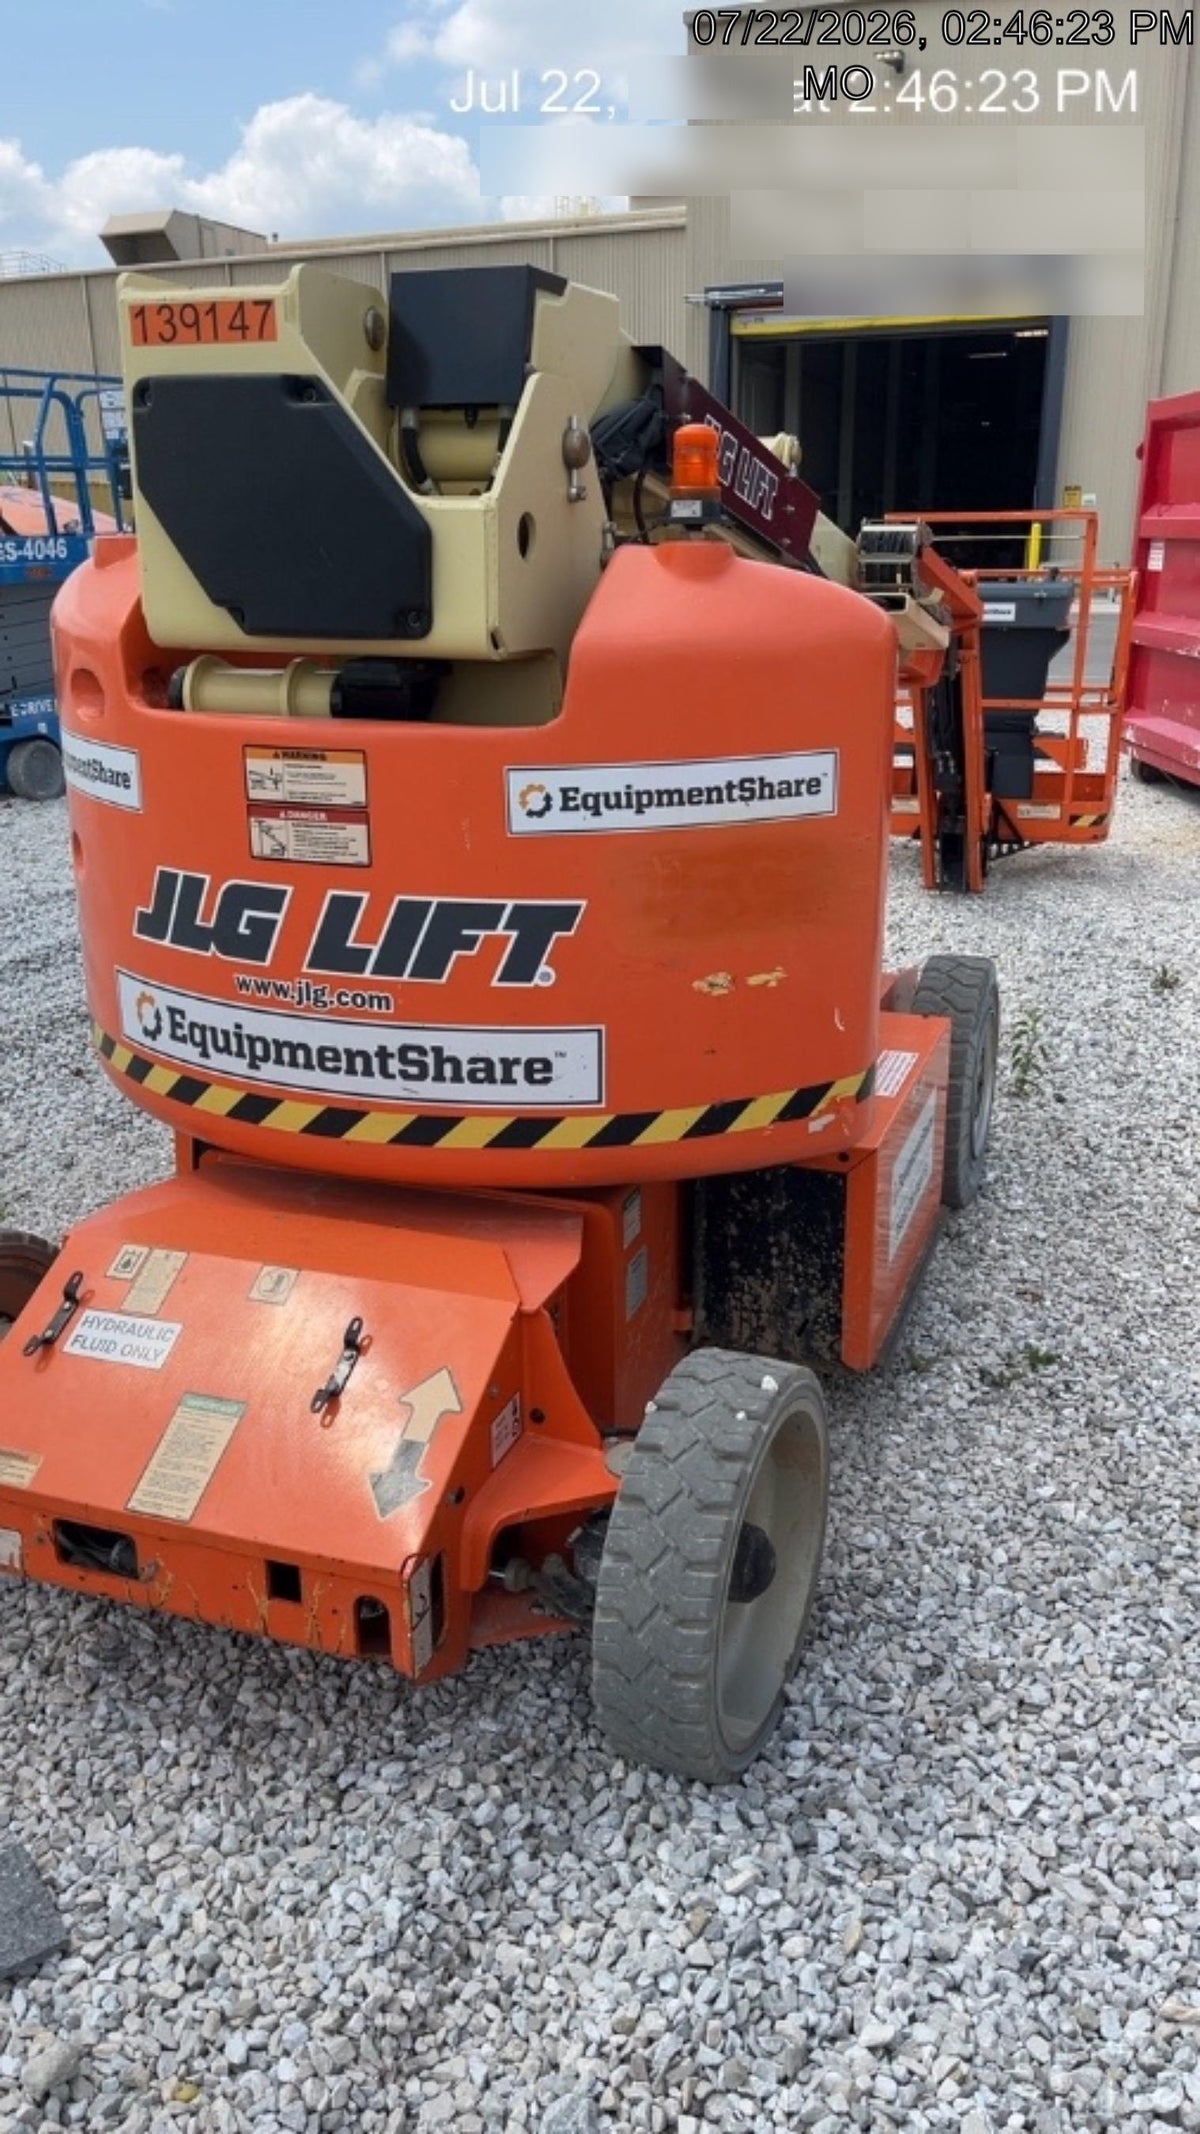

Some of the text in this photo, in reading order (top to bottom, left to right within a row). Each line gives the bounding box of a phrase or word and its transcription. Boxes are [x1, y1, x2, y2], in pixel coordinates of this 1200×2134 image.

[133, 300, 273, 343] 139147
[733, 446, 779, 521] LIFT
[559, 776, 822, 817] EquipmentShare
[133, 866, 587, 987] JLG LIFT
[234, 974, 392, 1011] www.jlg.com
[165, 1005, 555, 1086] EquipmentShare
[70, 1334, 166, 1362] FLUID ONLY
[80, 1315, 175, 1342] HYDRAULIC
